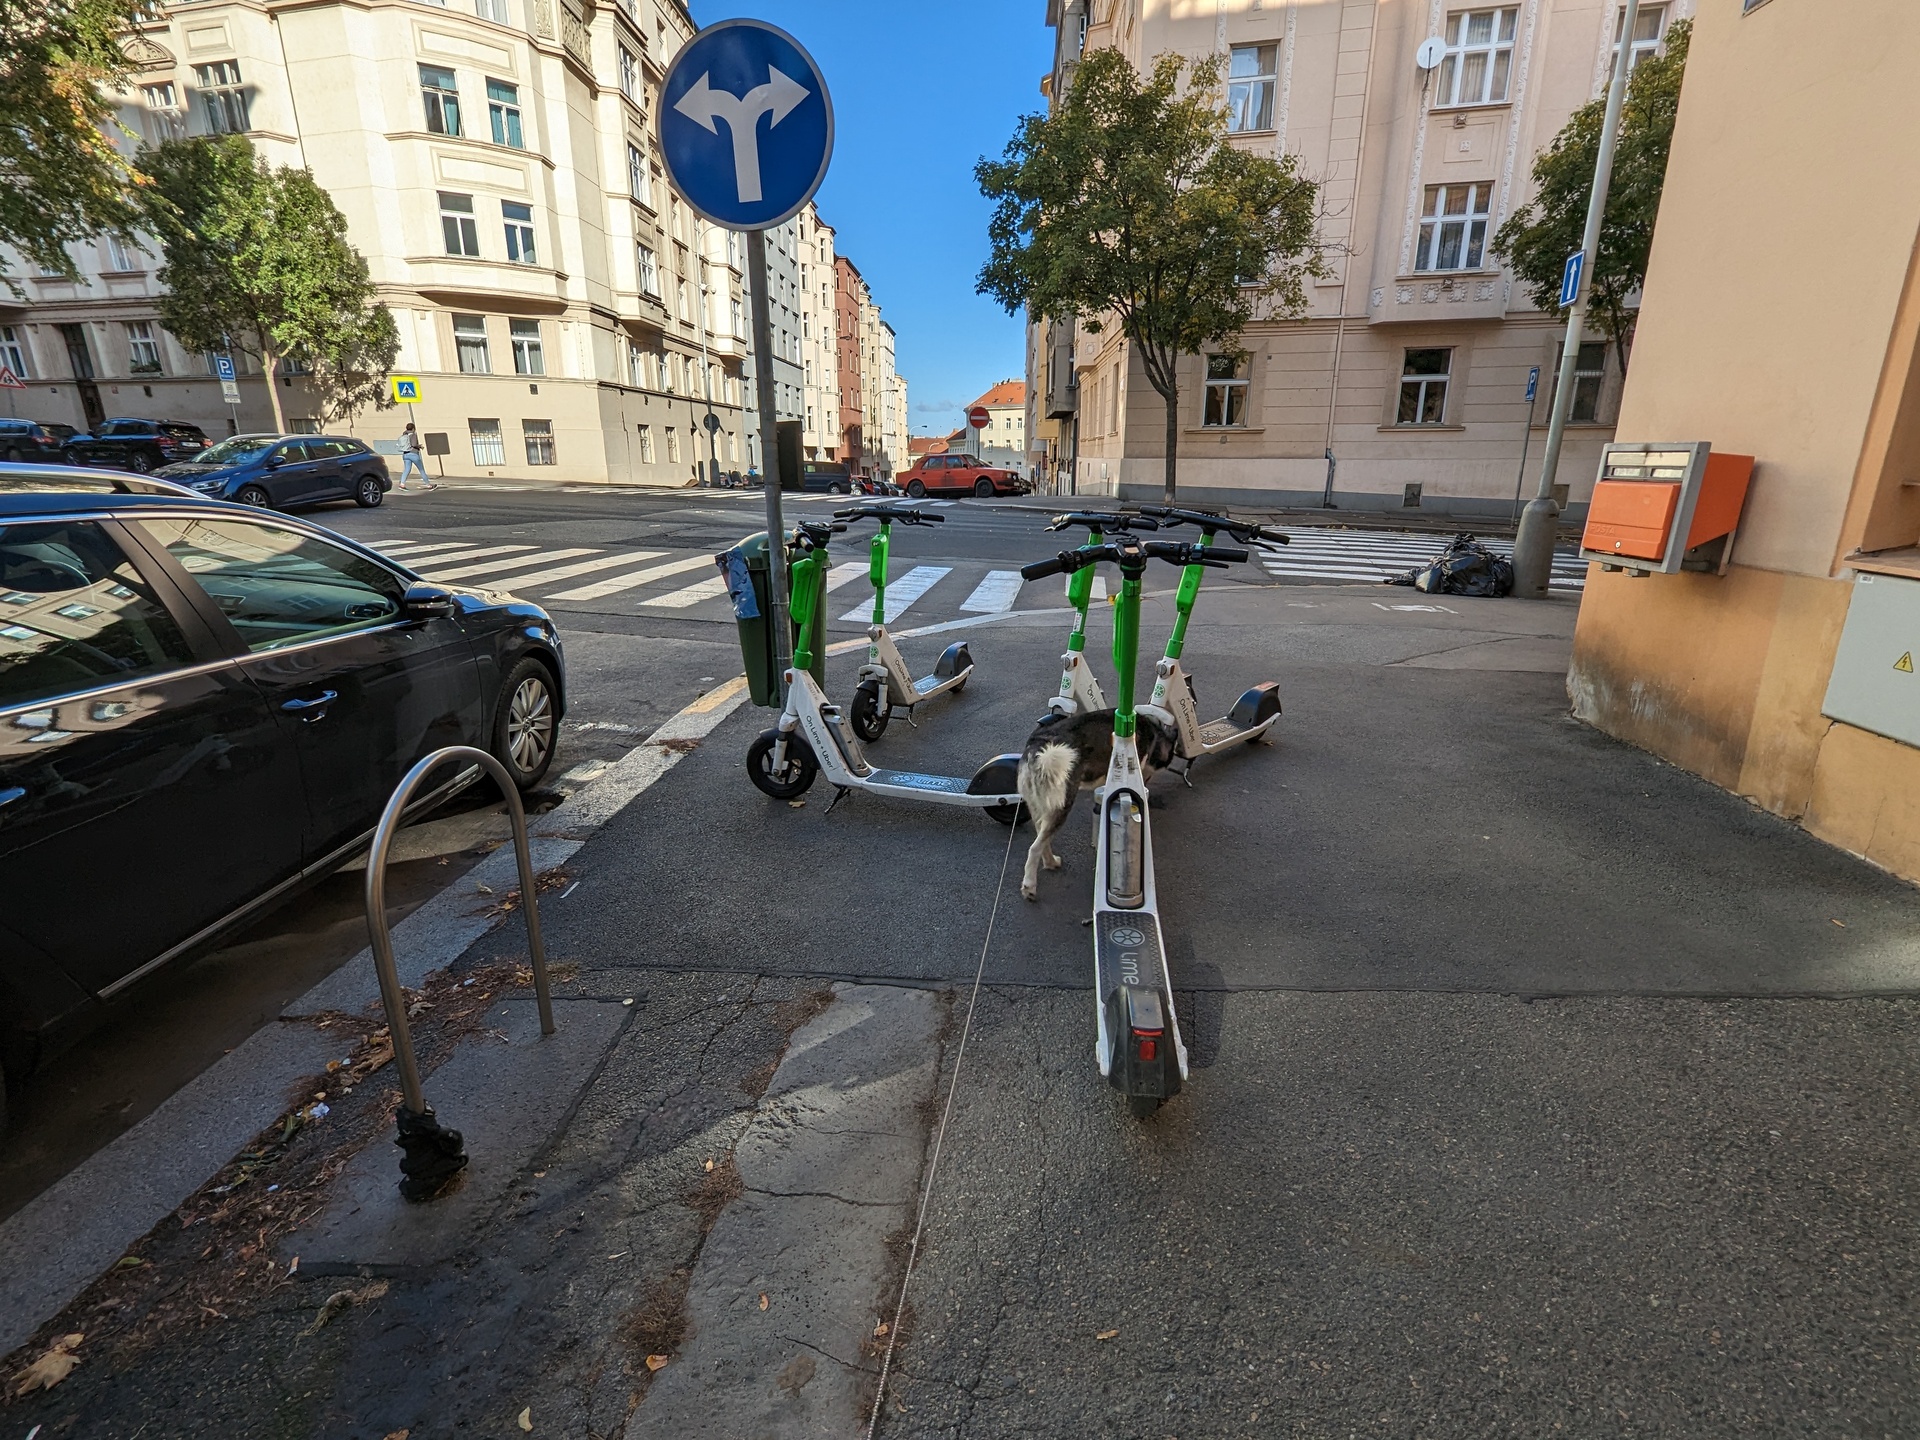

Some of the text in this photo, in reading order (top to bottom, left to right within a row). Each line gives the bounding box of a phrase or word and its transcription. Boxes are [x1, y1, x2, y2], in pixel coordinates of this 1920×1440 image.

[219, 360, 229, 374] P
[1529, 372, 1536, 391] P
[806, 715, 813, 728] On
[810, 726, 822, 745] Lime
[822, 750, 834, 768] Uber
